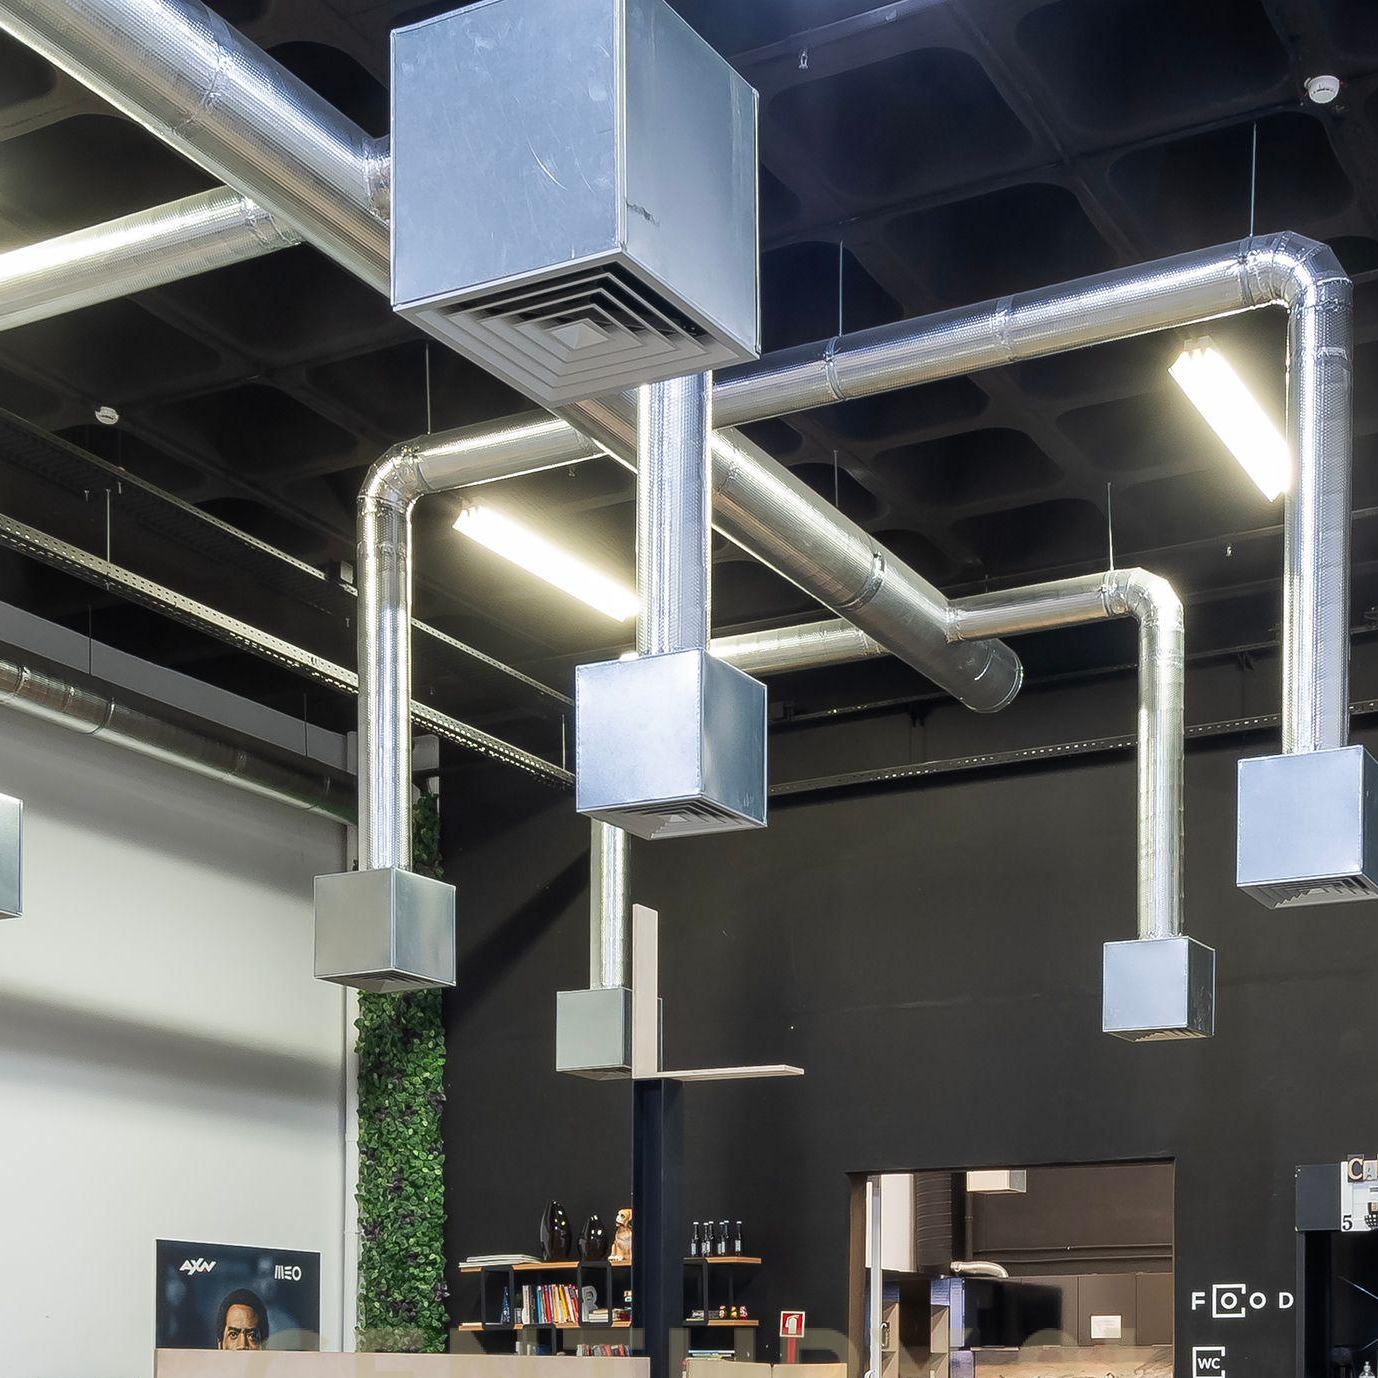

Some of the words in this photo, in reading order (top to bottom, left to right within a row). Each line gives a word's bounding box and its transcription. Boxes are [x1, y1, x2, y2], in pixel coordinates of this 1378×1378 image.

[1342, 1214, 1353, 1231] 5
[179, 1257, 217, 1276] AXN
[274, 1264, 302, 1281] MEO
[1191, 1290, 1294, 1311] FOOD
[1196, 1357, 1221, 1370] WC
